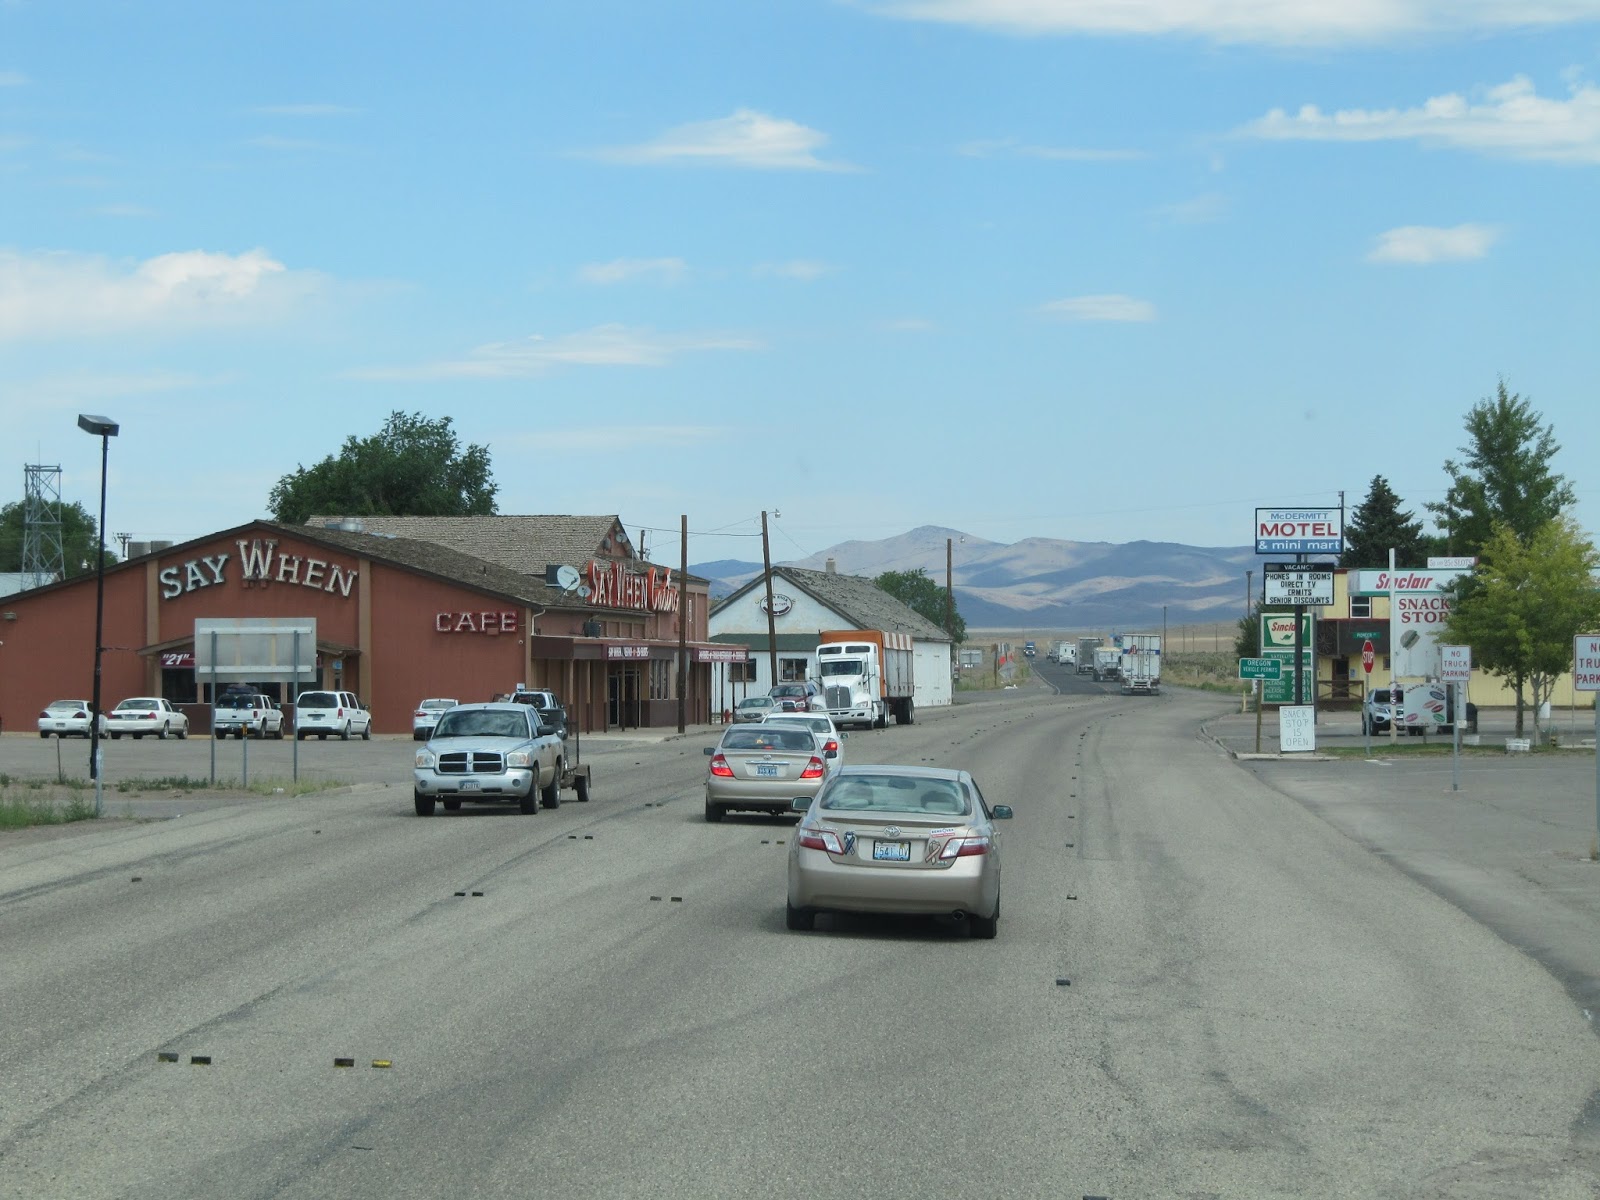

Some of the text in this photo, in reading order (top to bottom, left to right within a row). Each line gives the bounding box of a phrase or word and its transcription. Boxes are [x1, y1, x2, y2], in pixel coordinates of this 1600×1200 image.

[1270, 512, 1329, 520] McDERMITT
[1260, 522, 1338, 537] MOTEL
[1258, 540, 1340, 550] & mini mart
[160, 538, 359, 599] SAY WHEN
[587, 560, 614, 608] SAY
[613, 561, 648, 610] WHEN
[1375, 573, 1433, 589] Sinclair
[1269, 596, 1330, 604] SENIOR DISCOUNTS
[1398, 598, 1451, 610] SNACK
[434, 610, 518, 632] CAFE
[1401, 611, 1450, 624] STOP
[1590, 643, 1600, 653] N
[1362, 651, 1374, 664] STOP
[1450, 650, 1461, 658] NO
[1444, 660, 1468, 668] TRUCK
[1283, 710, 1308, 719] SNACK
[1285, 719, 1309, 728] STOP
[1293, 728, 1302, 737] IS
[1285, 737, 1309, 747] OPEN
